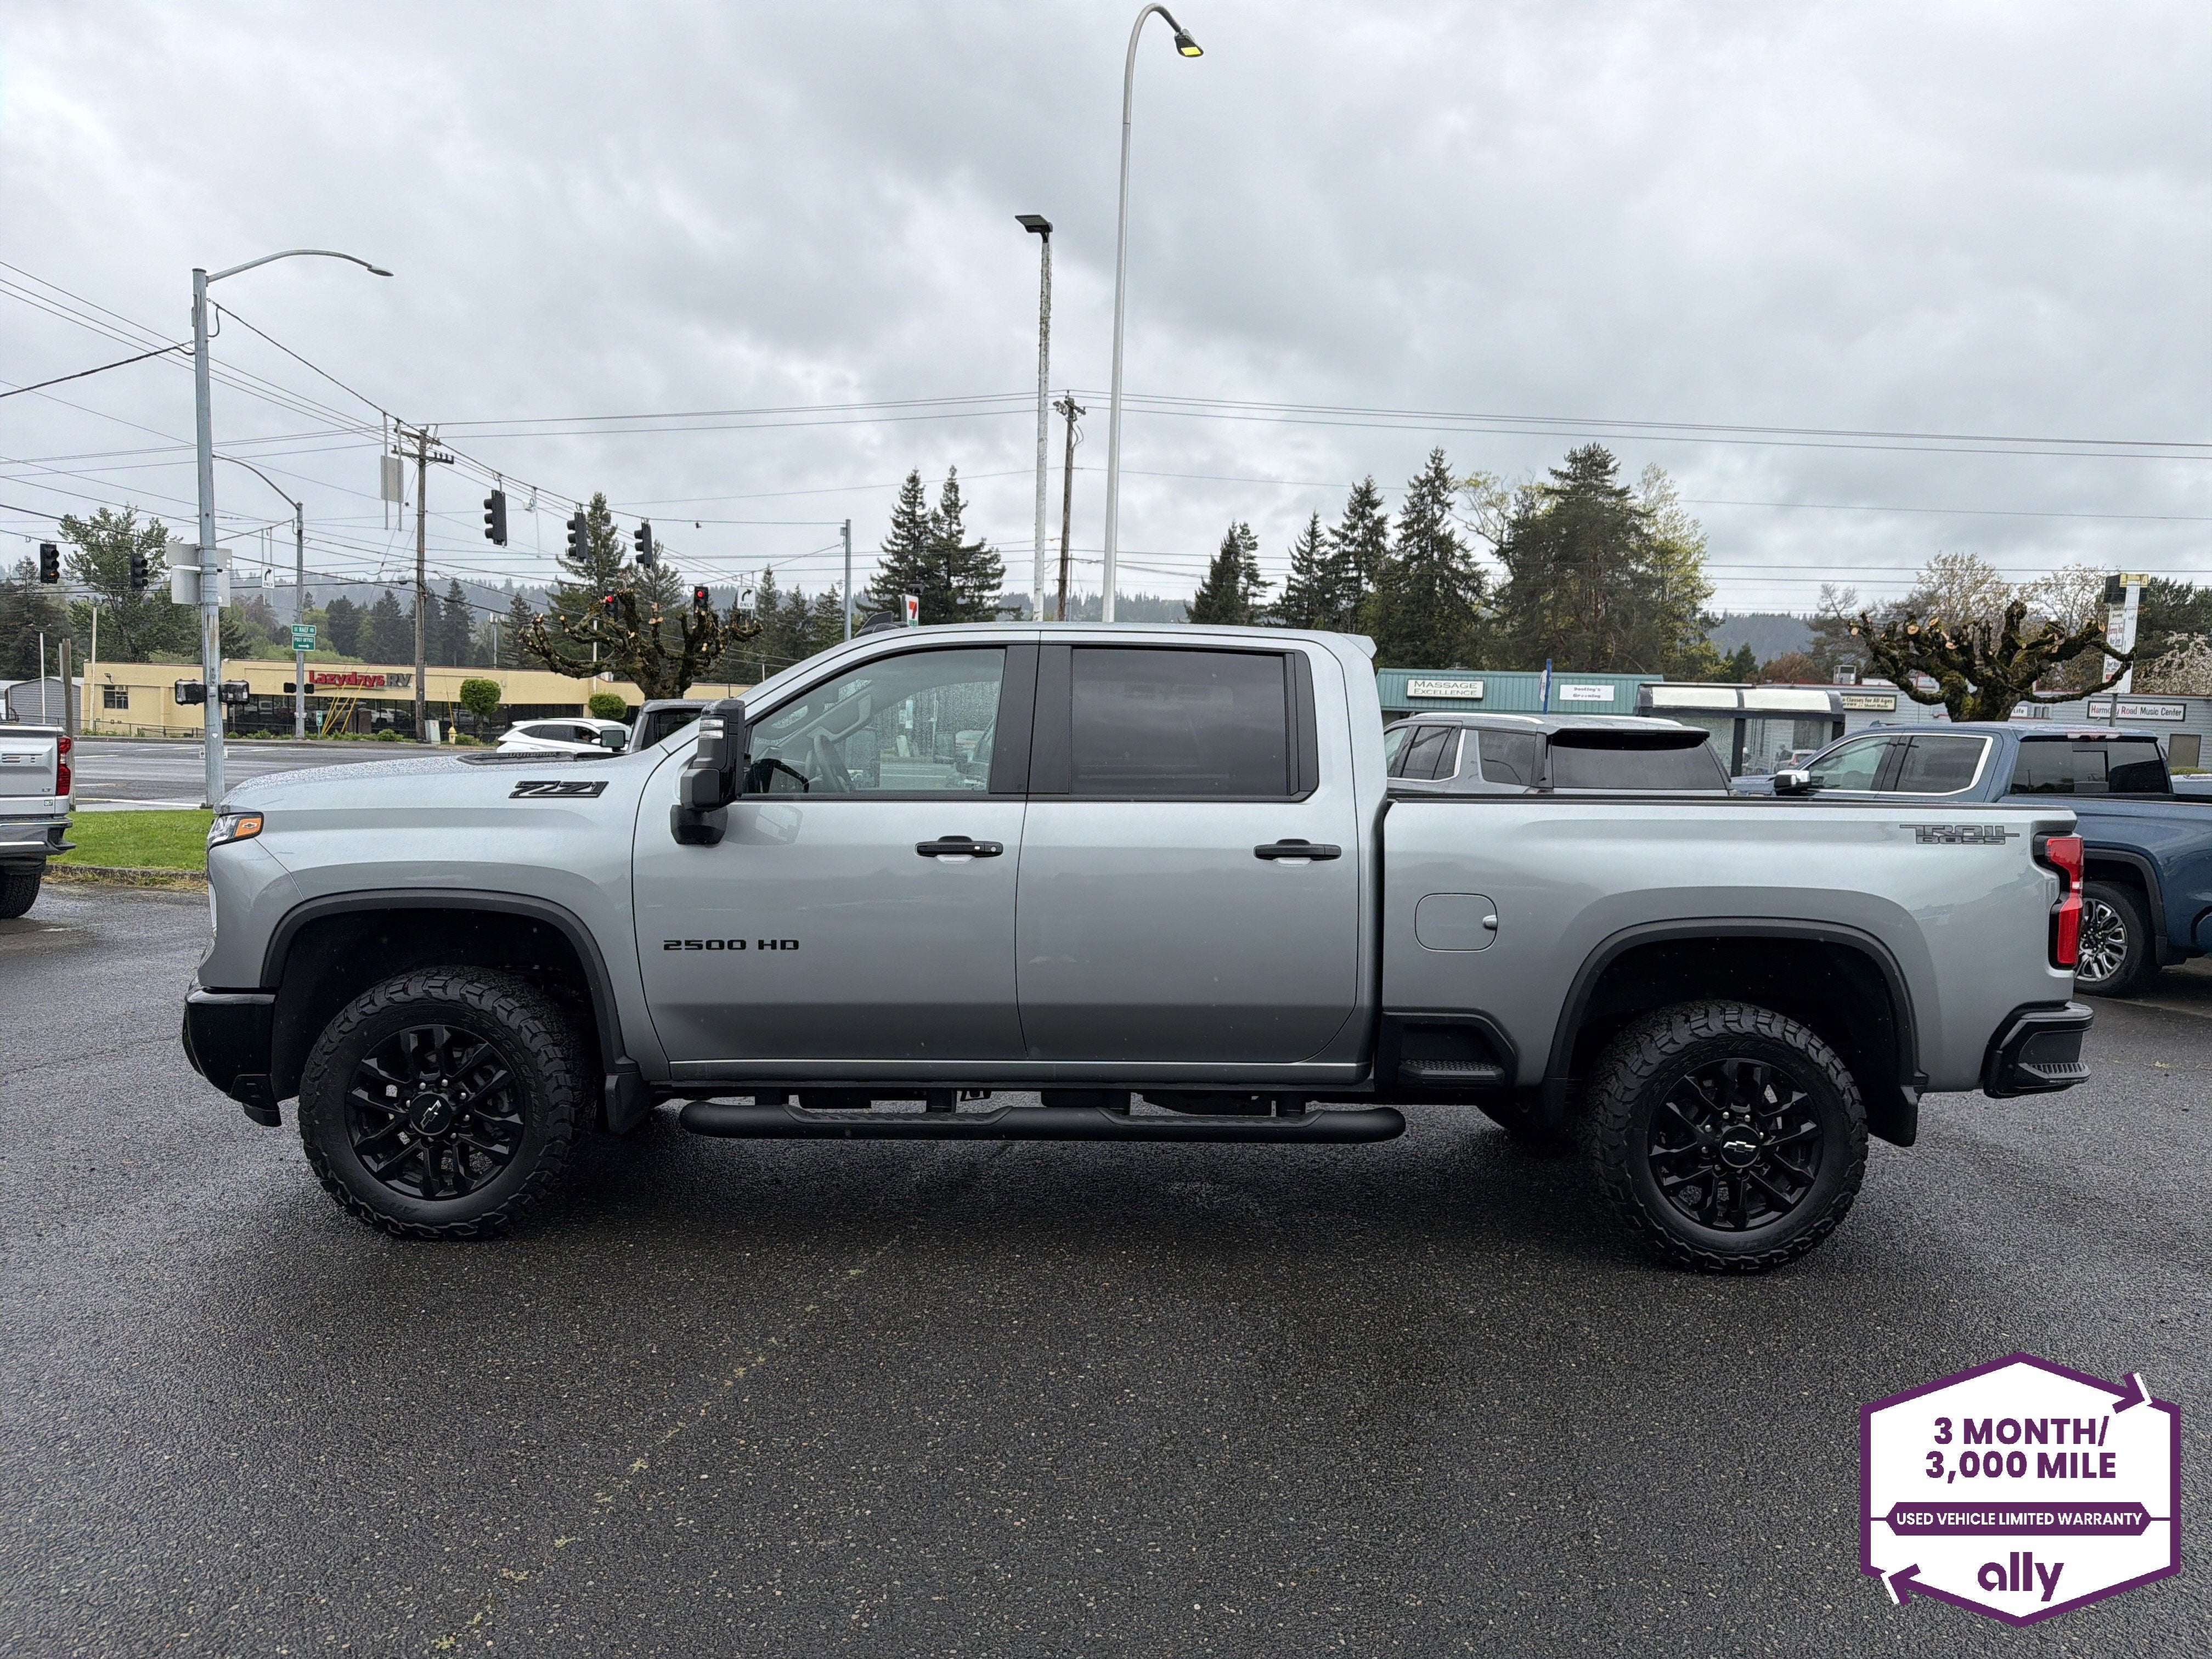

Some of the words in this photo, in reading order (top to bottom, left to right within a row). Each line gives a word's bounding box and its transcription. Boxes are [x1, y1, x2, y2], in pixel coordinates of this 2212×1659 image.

[909, 600, 917, 619] 7
[309, 670, 385, 687] Lazydays
[386, 673, 411, 687] RV
[2121, 706, 2138, 715] Road
[2140, 706, 2159, 715] Music
[2160, 707, 2182, 716] Center
[508, 781, 609, 798] Z71
[1899, 824, 2021, 838] TRAIL
[1916, 836, 2006, 845] BOSS
[663, 939, 747, 951] 2500
[758, 939, 799, 950] HD
